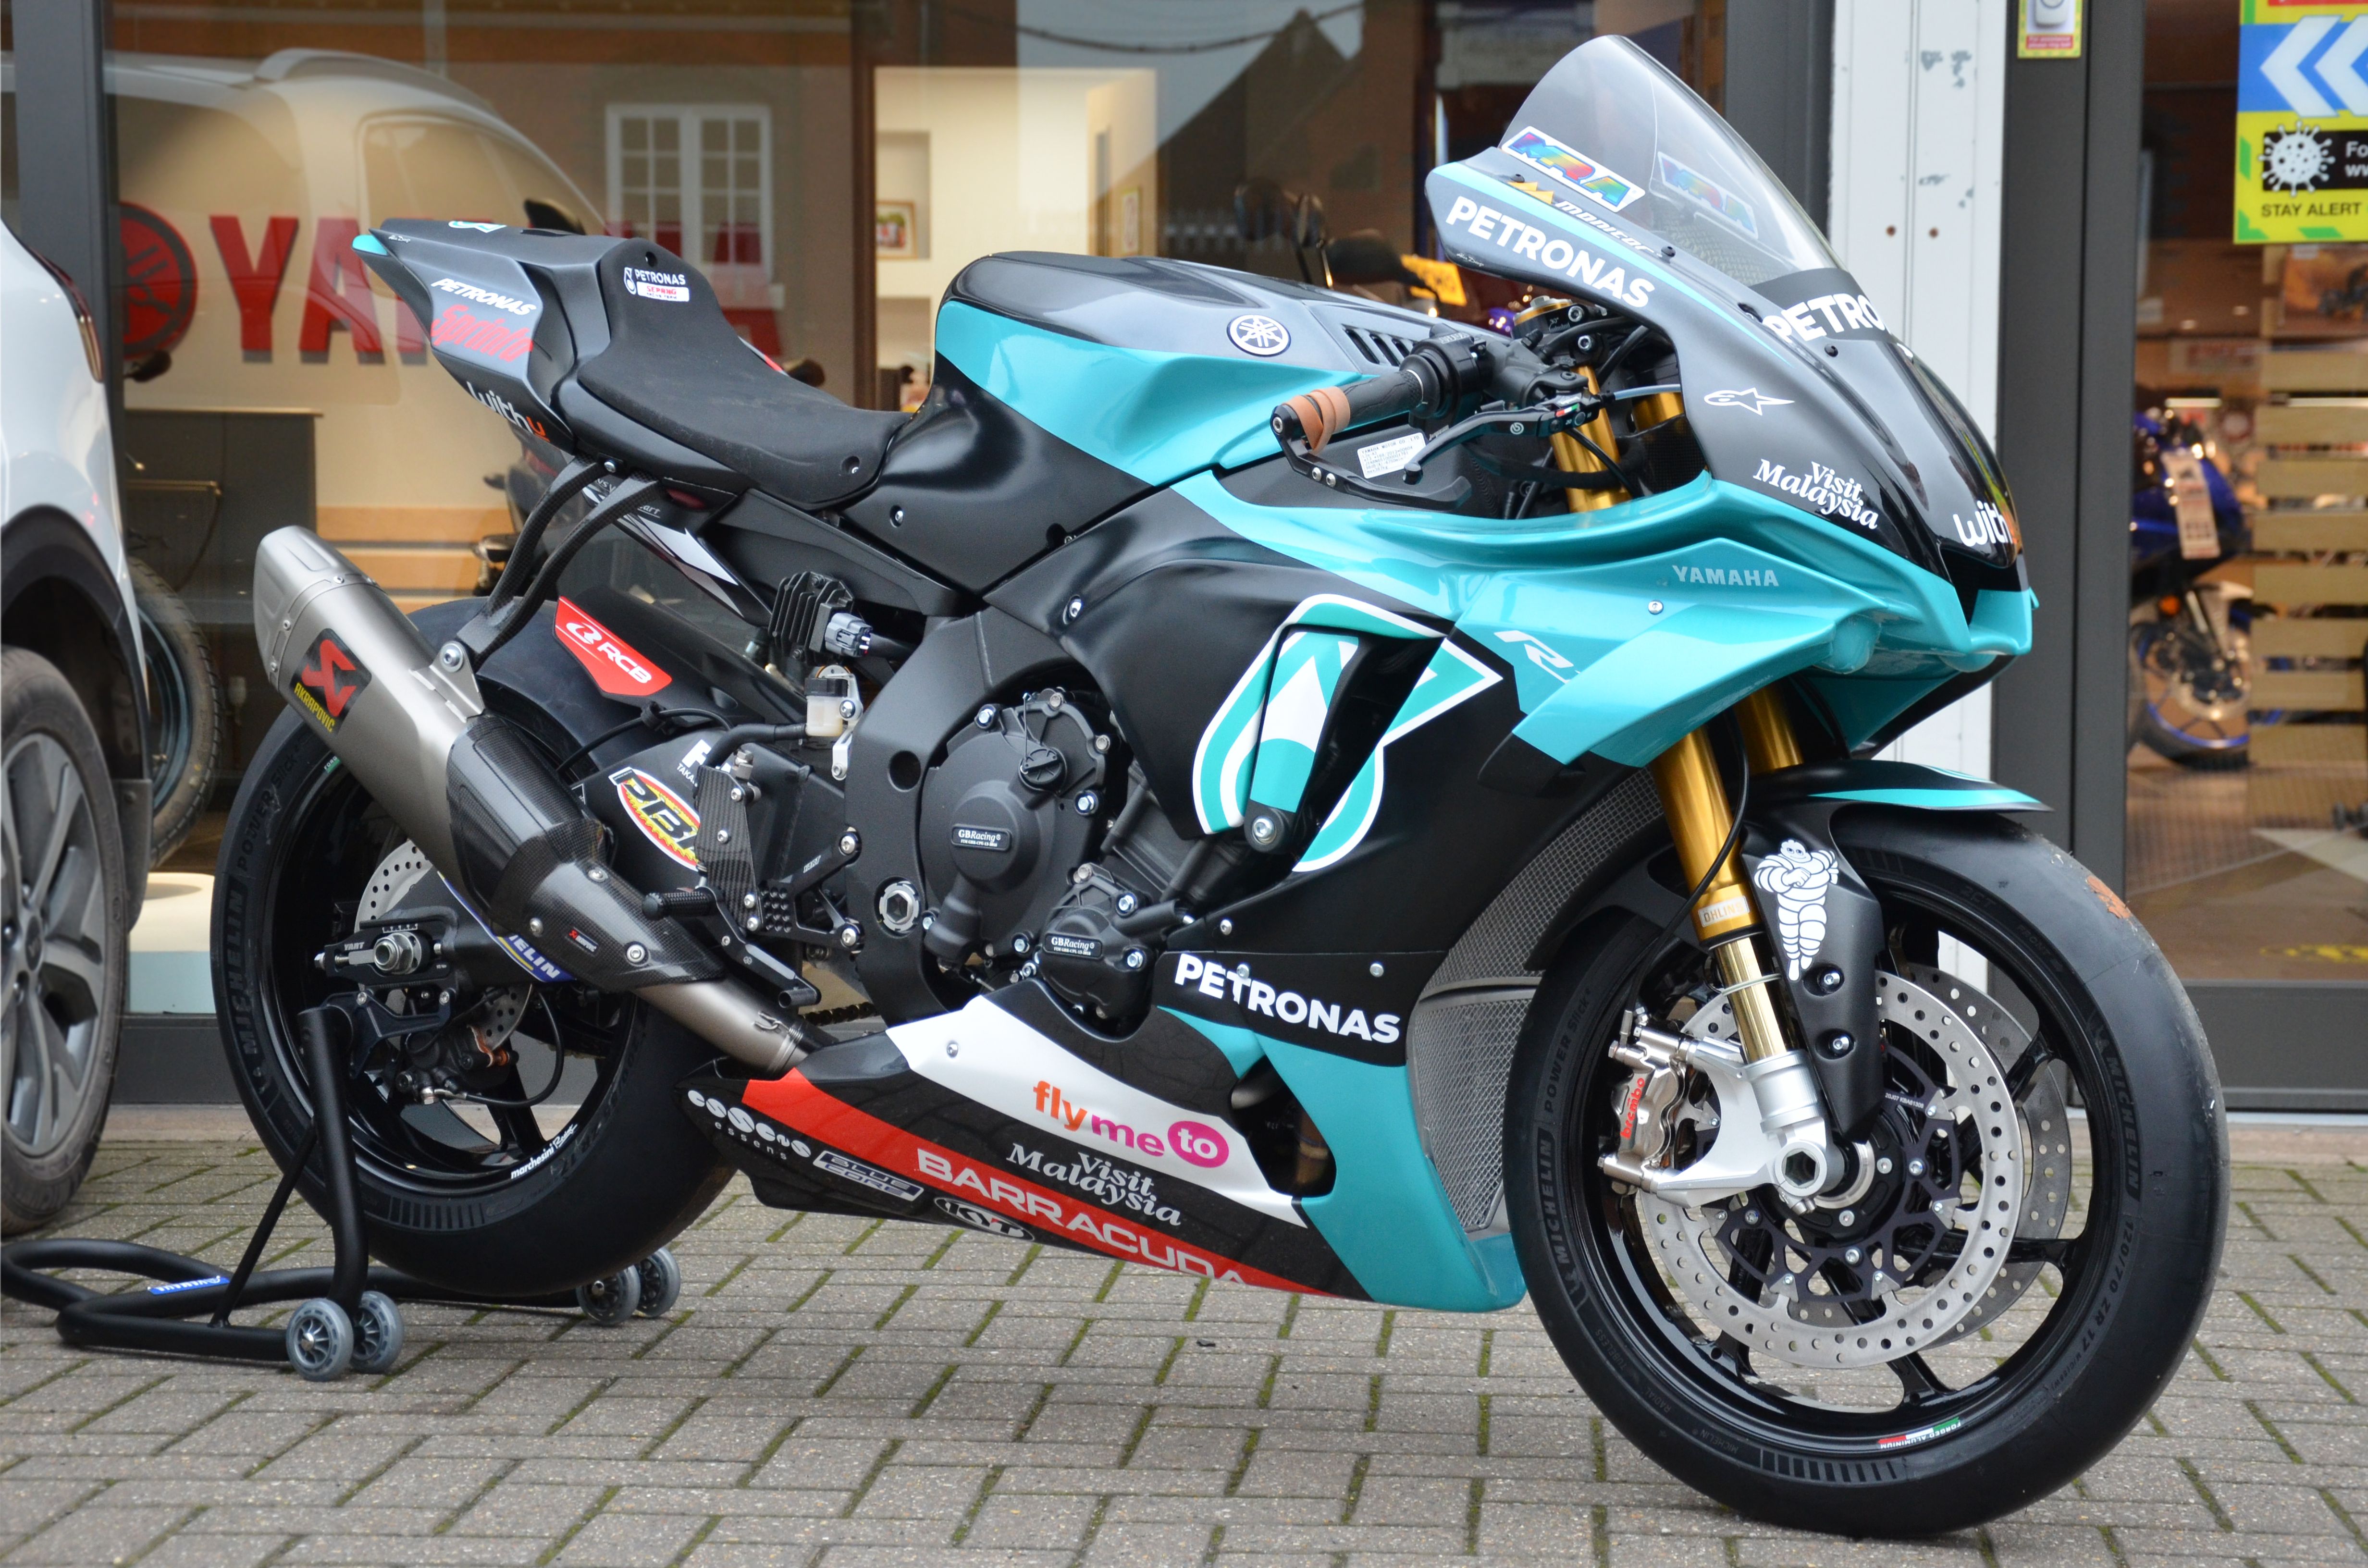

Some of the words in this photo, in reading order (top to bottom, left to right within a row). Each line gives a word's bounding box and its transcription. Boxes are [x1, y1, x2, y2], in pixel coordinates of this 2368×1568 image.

[2261, 203, 2302, 217] STAY
[2307, 202, 2362, 217] ALERT
[1445, 196, 1655, 307] PETRONAS
[634, 268, 686, 285] PETRONAS
[431, 278, 537, 316] PETRONAS
[1762, 293, 1892, 343] PETRO
[1381, 441, 1396, 449] MOTOR
[1752, 458, 1879, 530] Malaysia
[1811, 461, 1865, 502] Visit
[1672, 565, 1780, 587] YAMAHA
[597, 641, 652, 684] RCB
[323, 755, 339, 772] FORG
[344, 942, 365, 951] YART
[227, 889, 258, 1057] MICHELIN
[1173, 952, 1401, 1045] PETRONAS
[1543, 1038, 1574, 1114] POWER
[1620, 1077, 1645, 1139] brembo
[2109, 1056, 2139, 1189] MICHELIN
[714, 1121, 788, 1162] essens
[510, 1143, 555, 1180] marchesini
[824, 1164, 905, 1197] CORE
[829, 1156, 912, 1191] BLUE
[1078, 1151, 1155, 1197] Visit
[1006, 1143, 1182, 1227] Malaysia
[1541, 1138, 1570, 1267] MICHELIN
[2109, 1220, 2134, 1293] 120/70
[2094, 1300, 2111, 1327] ZR
[2082, 1329, 2096, 1353] 17
[1699, 1428, 1739, 1455] MICHELIN
[1880, 1435, 1926, 1450] ALUMINIUM
[1929, 1419, 1962, 1439] FORGED
